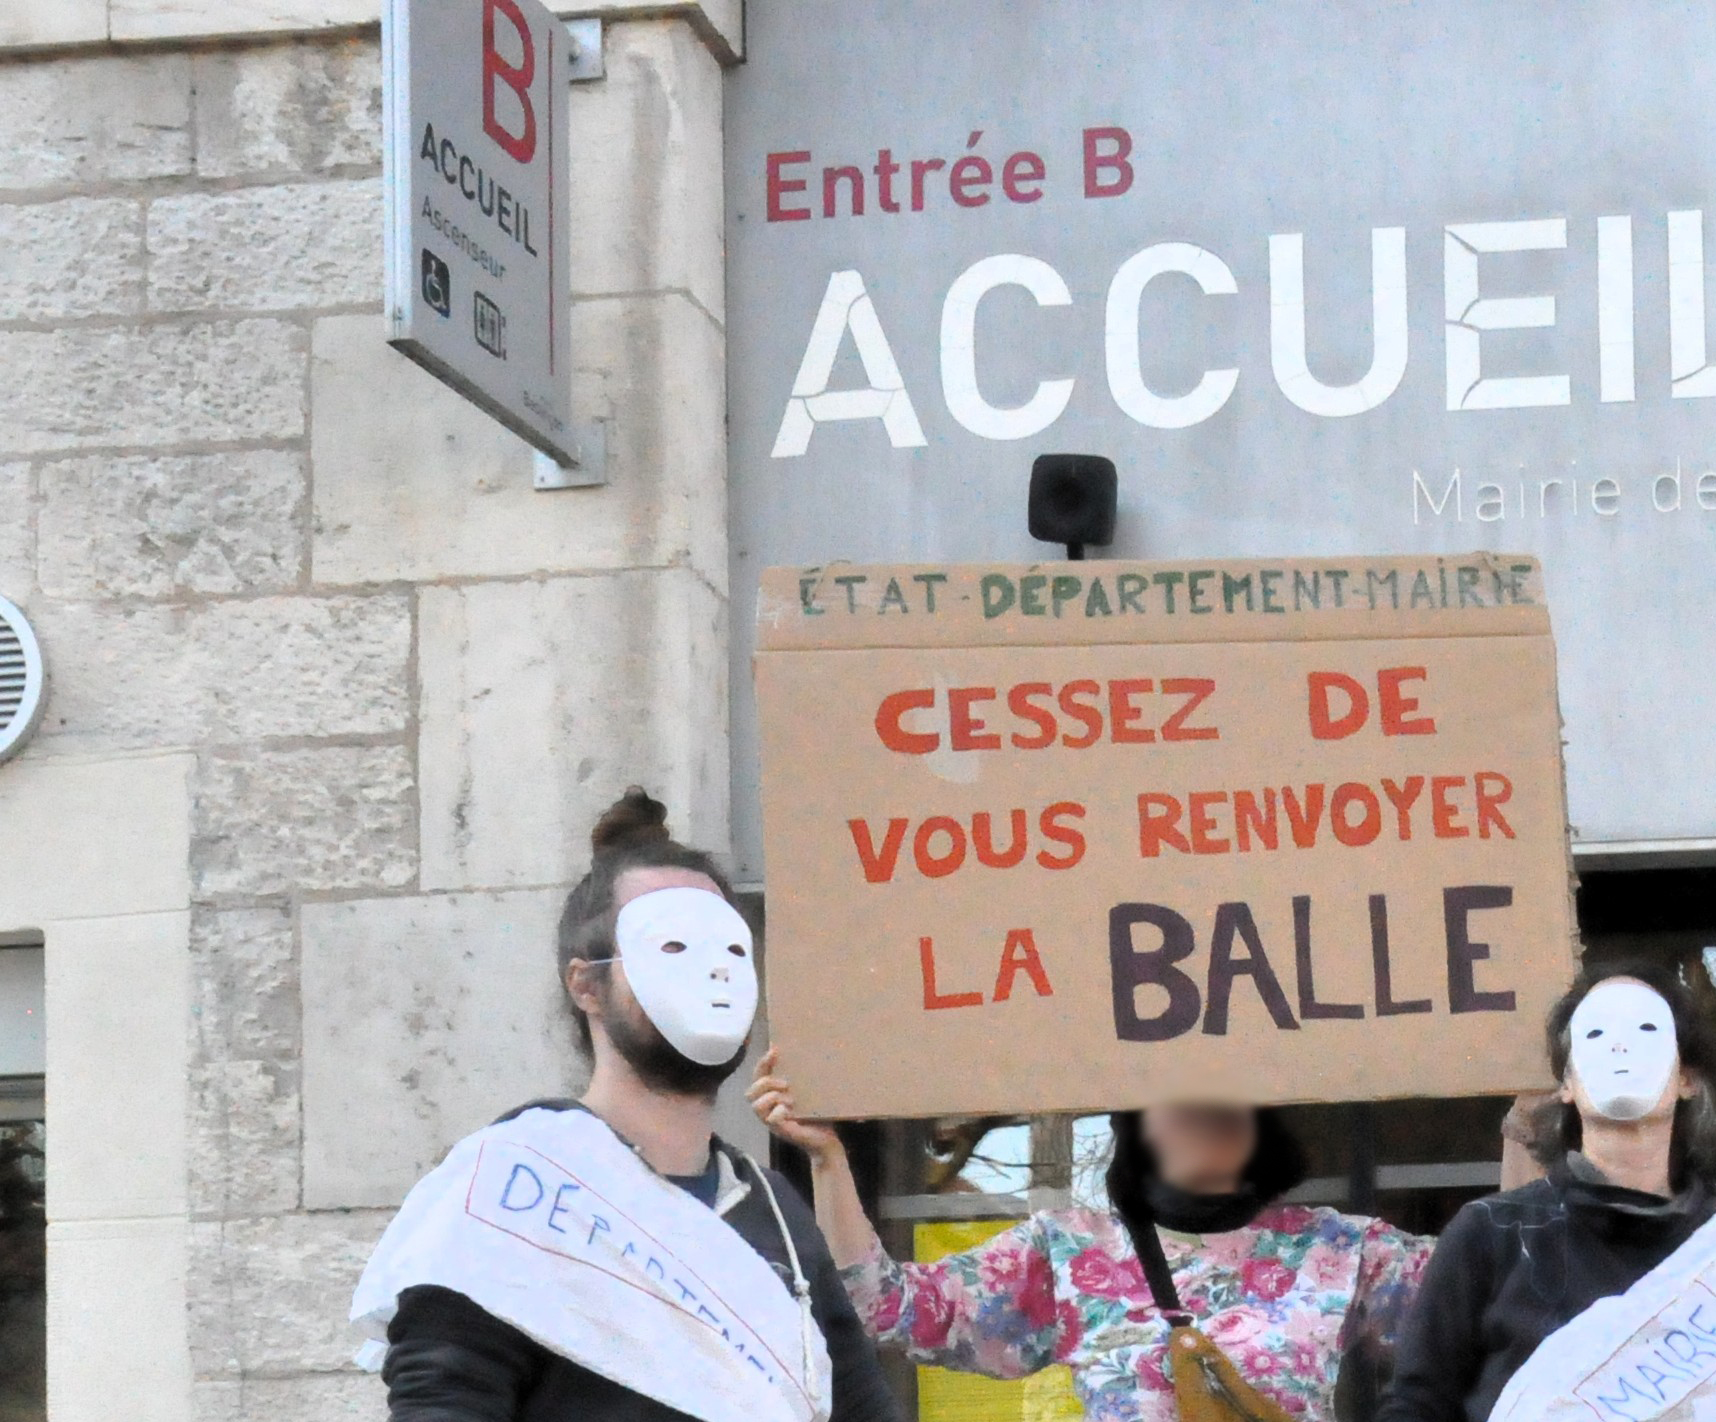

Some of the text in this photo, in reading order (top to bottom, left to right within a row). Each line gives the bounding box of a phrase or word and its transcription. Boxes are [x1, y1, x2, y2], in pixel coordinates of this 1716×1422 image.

[482, 0, 537, 164] B
[420, 122, 538, 258] ACCUEIL
[765, 125, 1136, 224] Entrée B
[421, 195, 507, 281] Ascenseur
[1412, 459, 1623, 525] Mairie
[874, 666, 1439, 755] CESSEZ DE
[848, 770, 1518, 884] VOUS RENVOYER
[918, 886, 1518, 1043] LA BALLE
